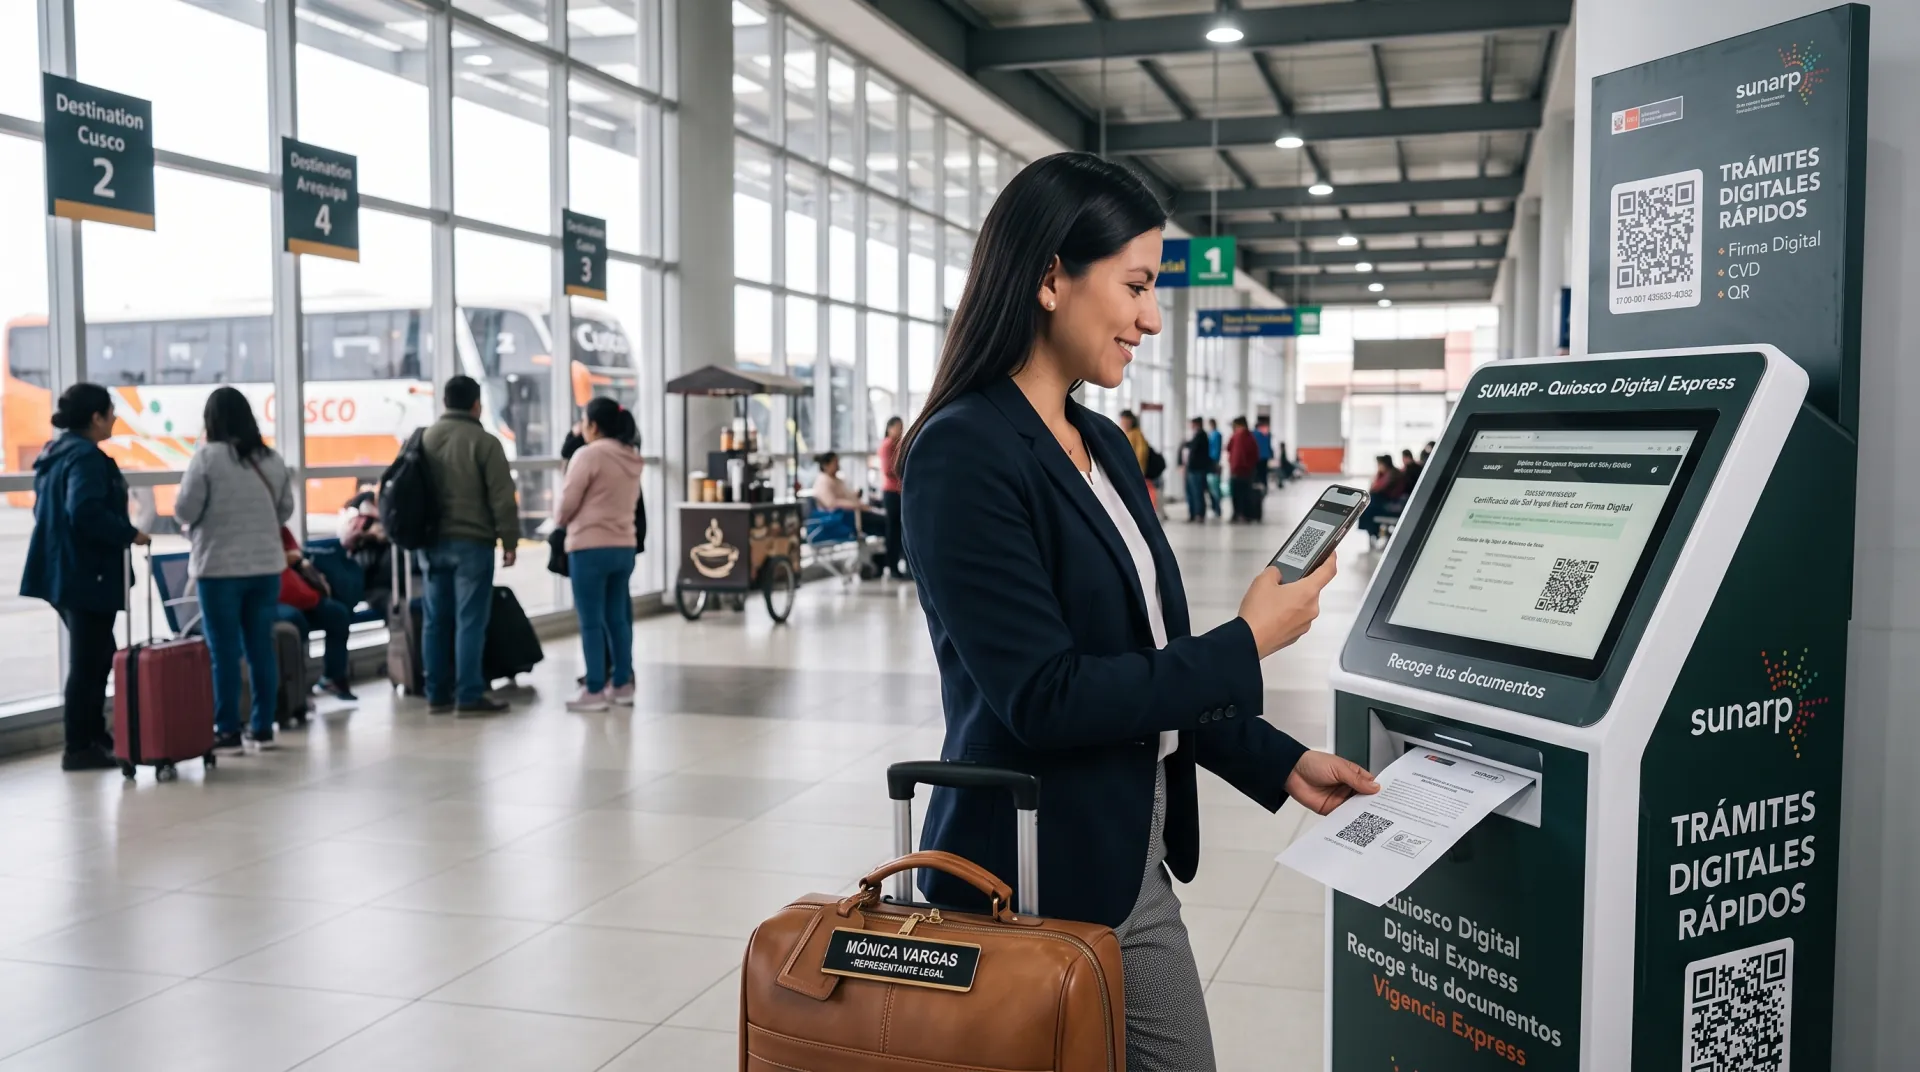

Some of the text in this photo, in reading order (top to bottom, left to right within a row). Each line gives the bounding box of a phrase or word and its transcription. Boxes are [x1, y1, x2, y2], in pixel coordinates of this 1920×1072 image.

[1736, 71, 1801, 99] sunarp
[56, 92, 144, 131] Destination
[77, 125, 125, 152] Cusco
[93, 157, 115, 198] 2
[290, 151, 352, 180] Destination
[1719, 147, 1820, 182] TRÁMITES
[1719, 171, 1821, 206] DIGITALES
[314, 204, 332, 236] 4
[1719, 198, 1807, 229] RÁPIDOS
[1728, 229, 1821, 258] Firma Digital
[581, 256, 592, 284] 3
[1204, 247, 1221, 273] 1
[1728, 261, 1761, 279] CVD
[1727, 284, 1750, 300] QR
[1477, 381, 1538, 399] SUNARP
[1547, 379, 1607, 397] Quiosco
[1609, 375, 1667, 398] Digital
[1667, 375, 1737, 396] Express
[264, 392, 356, 424] Csco
[1584, 501, 1606, 511] Firma
[1606, 502, 1633, 513] Digital
[1386, 652, 1547, 700] Recoge tus documentos
[1690, 697, 1793, 736] sunarp
[1671, 790, 1816, 847] TRÁMITES
[1669, 835, 1816, 896] DIGITALES
[1678, 882, 1806, 941] RÁPIDOS
[845, 938, 959, 967] MÓNICA VARGAS
[1458, 915, 1520, 960] Digital
[1384, 917, 1518, 993] Digital Express
[919, 968, 945, 979] LEGAL
[1347, 931, 1562, 1048] Recoge tus documentos
[1372, 973, 1526, 1066] Vigencia Express
